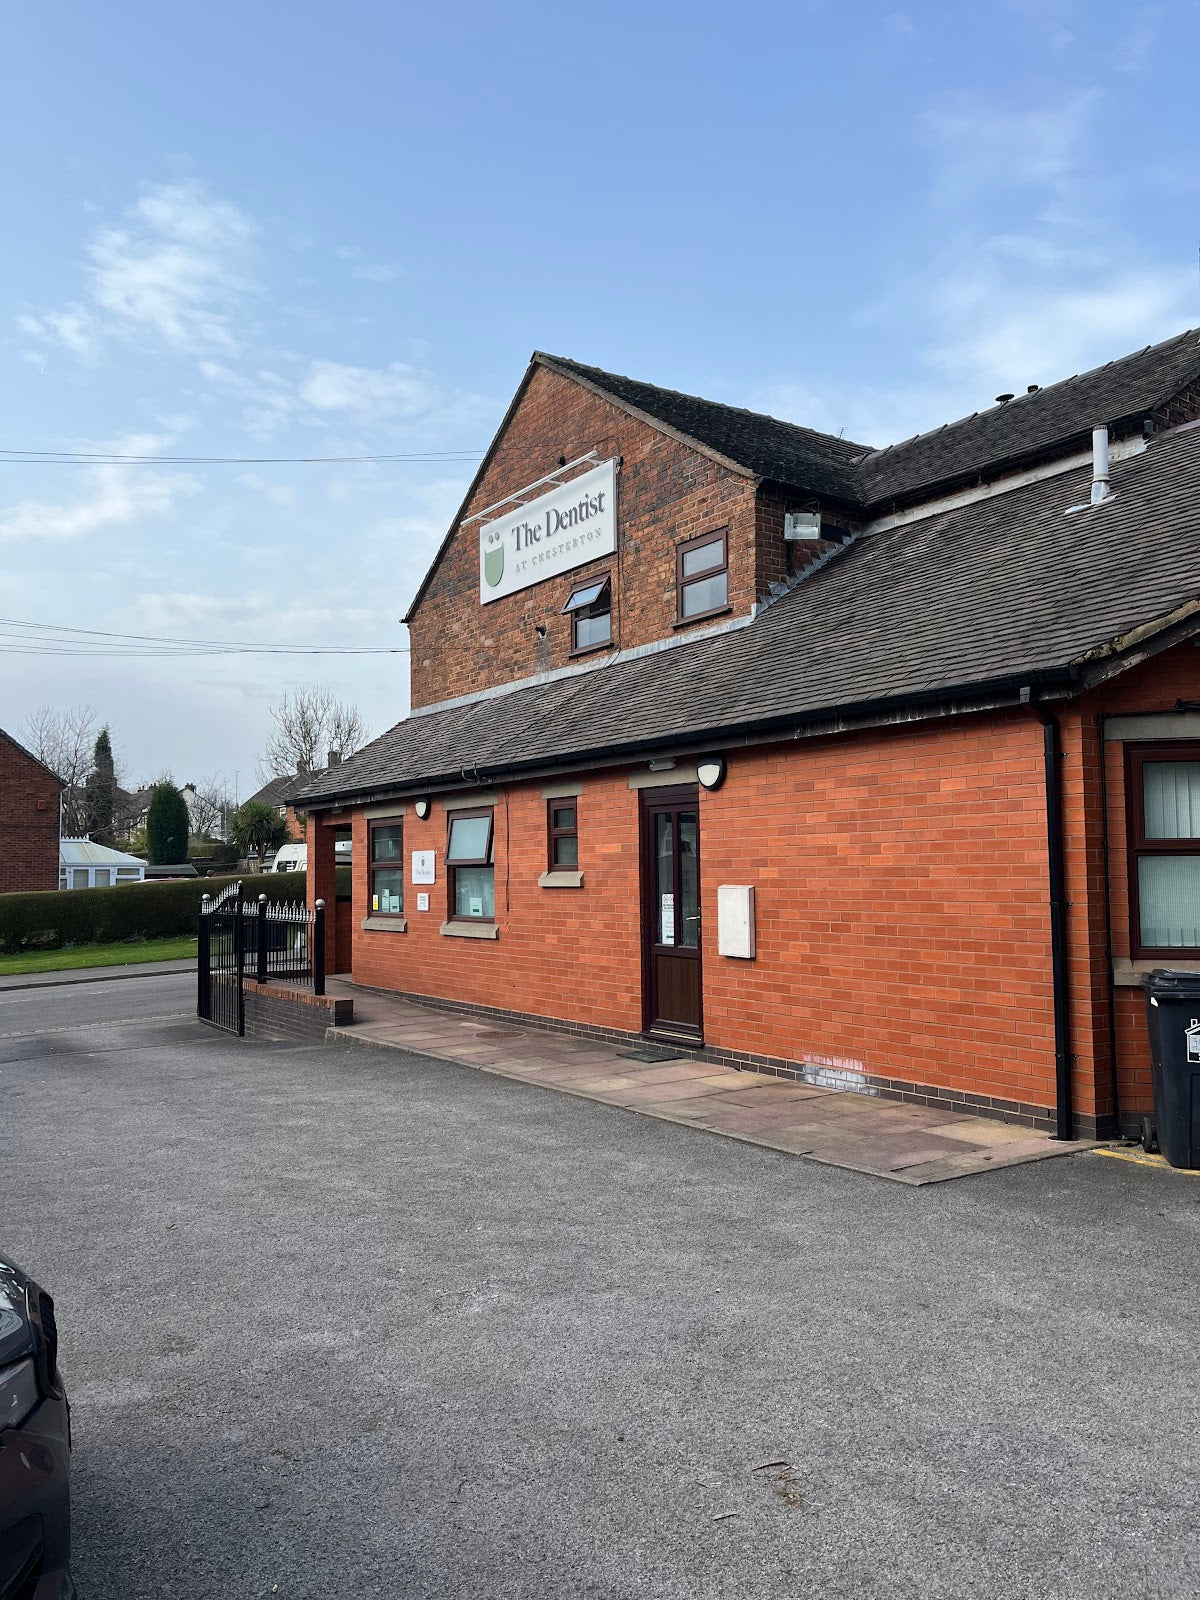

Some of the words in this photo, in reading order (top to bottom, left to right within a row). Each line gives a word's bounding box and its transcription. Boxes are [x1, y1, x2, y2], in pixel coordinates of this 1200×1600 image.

[511, 522, 542, 551] The
[545, 491, 605, 537] Dentist
[515, 560, 527, 573] AT
[532, 527, 602, 566] CHESTERTON
